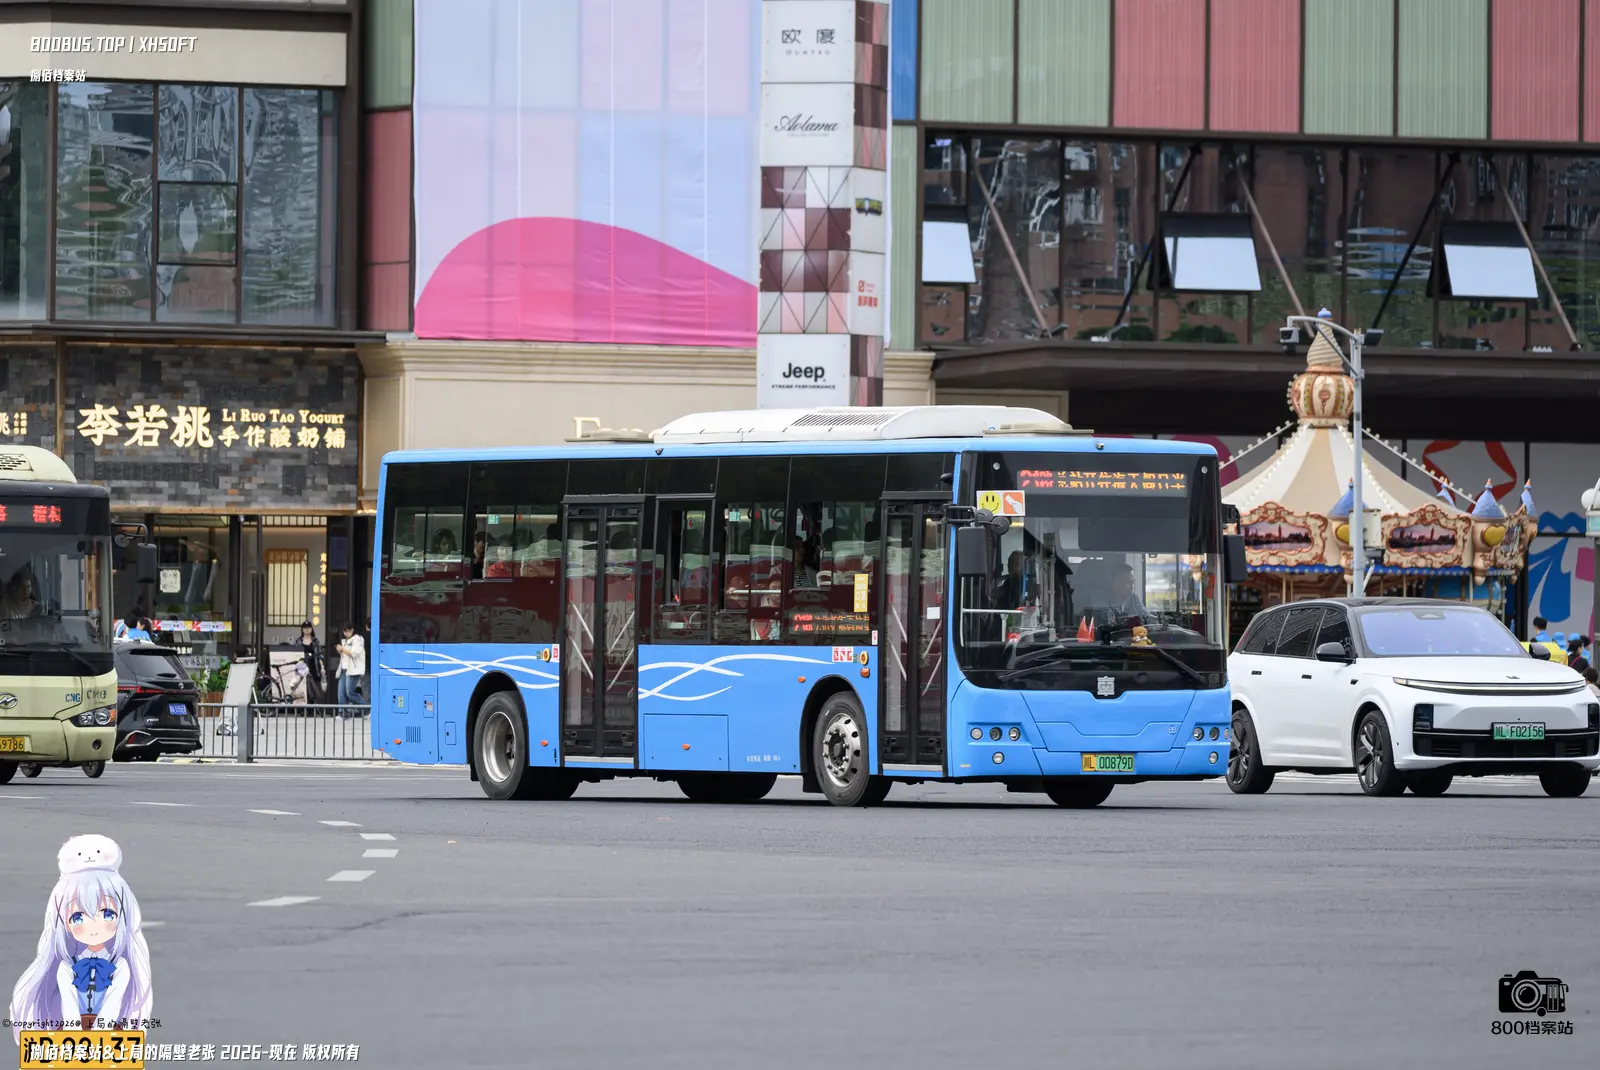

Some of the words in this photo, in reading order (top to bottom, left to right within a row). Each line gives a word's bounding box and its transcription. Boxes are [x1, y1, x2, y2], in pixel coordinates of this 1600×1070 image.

[782, 363, 826, 382] Jeep
[77, 403, 214, 448] 李若桃
[65, 693, 81, 702] CNG
[0, 739, 24, 750] 9786
